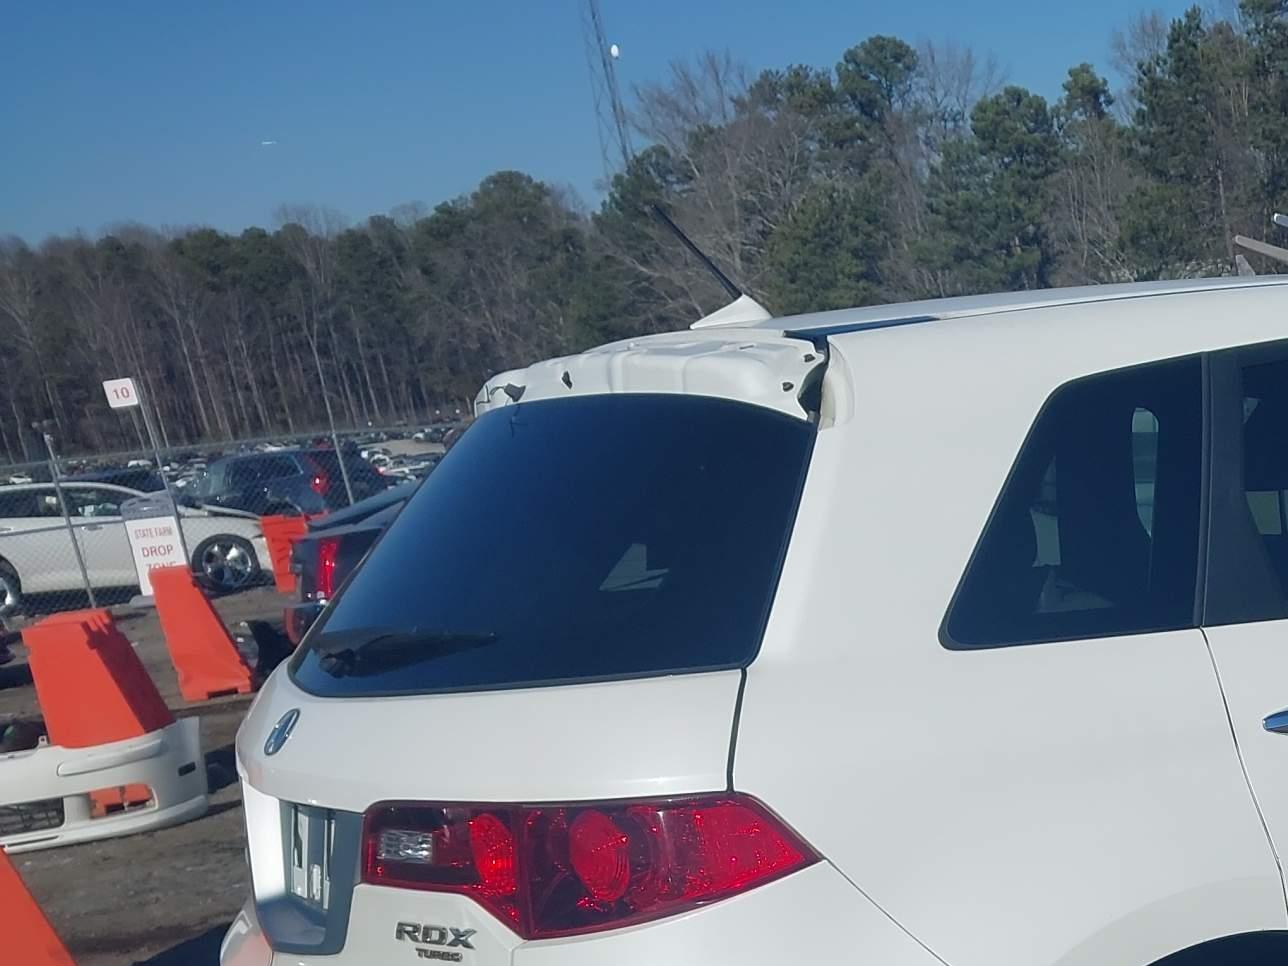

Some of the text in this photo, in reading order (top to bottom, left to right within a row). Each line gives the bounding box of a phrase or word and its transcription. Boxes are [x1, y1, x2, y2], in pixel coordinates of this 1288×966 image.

[113, 387, 130, 400] 10
[134, 526, 173, 539] STATE FARM
[142, 544, 173, 557] DROP
[395, 922, 478, 950] RDX
[415, 947, 463, 962] TURBO
